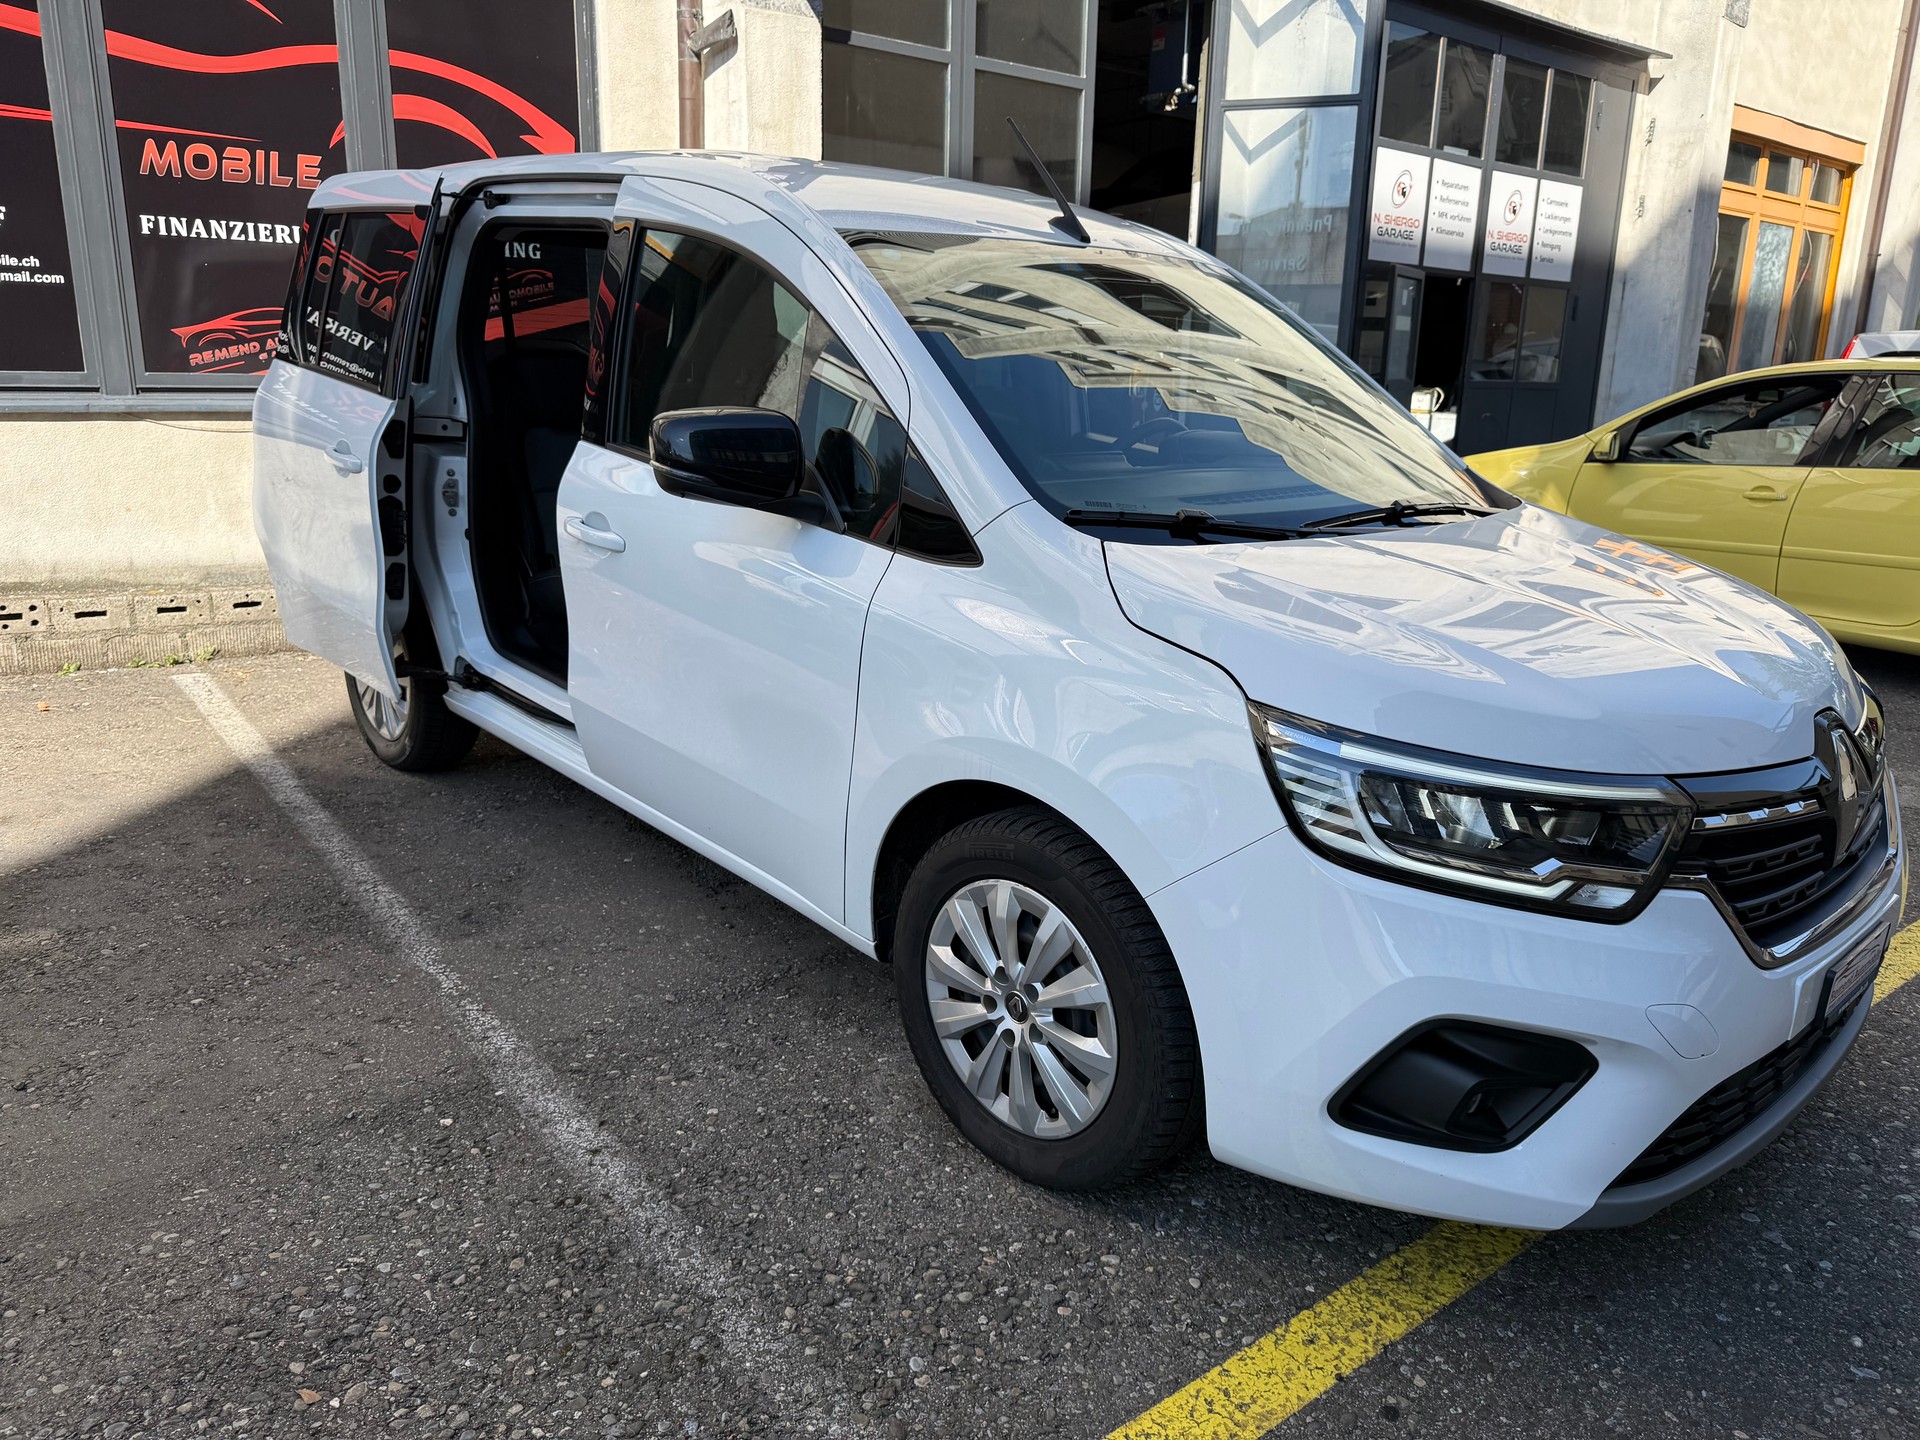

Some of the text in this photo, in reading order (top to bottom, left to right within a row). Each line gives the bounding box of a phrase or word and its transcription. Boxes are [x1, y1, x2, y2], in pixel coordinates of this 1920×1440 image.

[139, 138, 323, 190] MOBILE
[1441, 179, 1469, 191] Reparaturen
[1373, 213, 1420, 229] N. SHERGO
[1377, 227, 1414, 240] GARAGE
[1436, 226, 1464, 238] Klimaservice
[1487, 230, 1528, 243] N. SHERGO
[1490, 241, 1523, 254] GARAGE
[0, 254, 40, 267] ile.ch
[1539, 255, 1554, 264] Service
[0, 271, 65, 284] mail.com
[189, 342, 260, 367] REMEND
[1285, 730, 1316, 743] RENAULT
